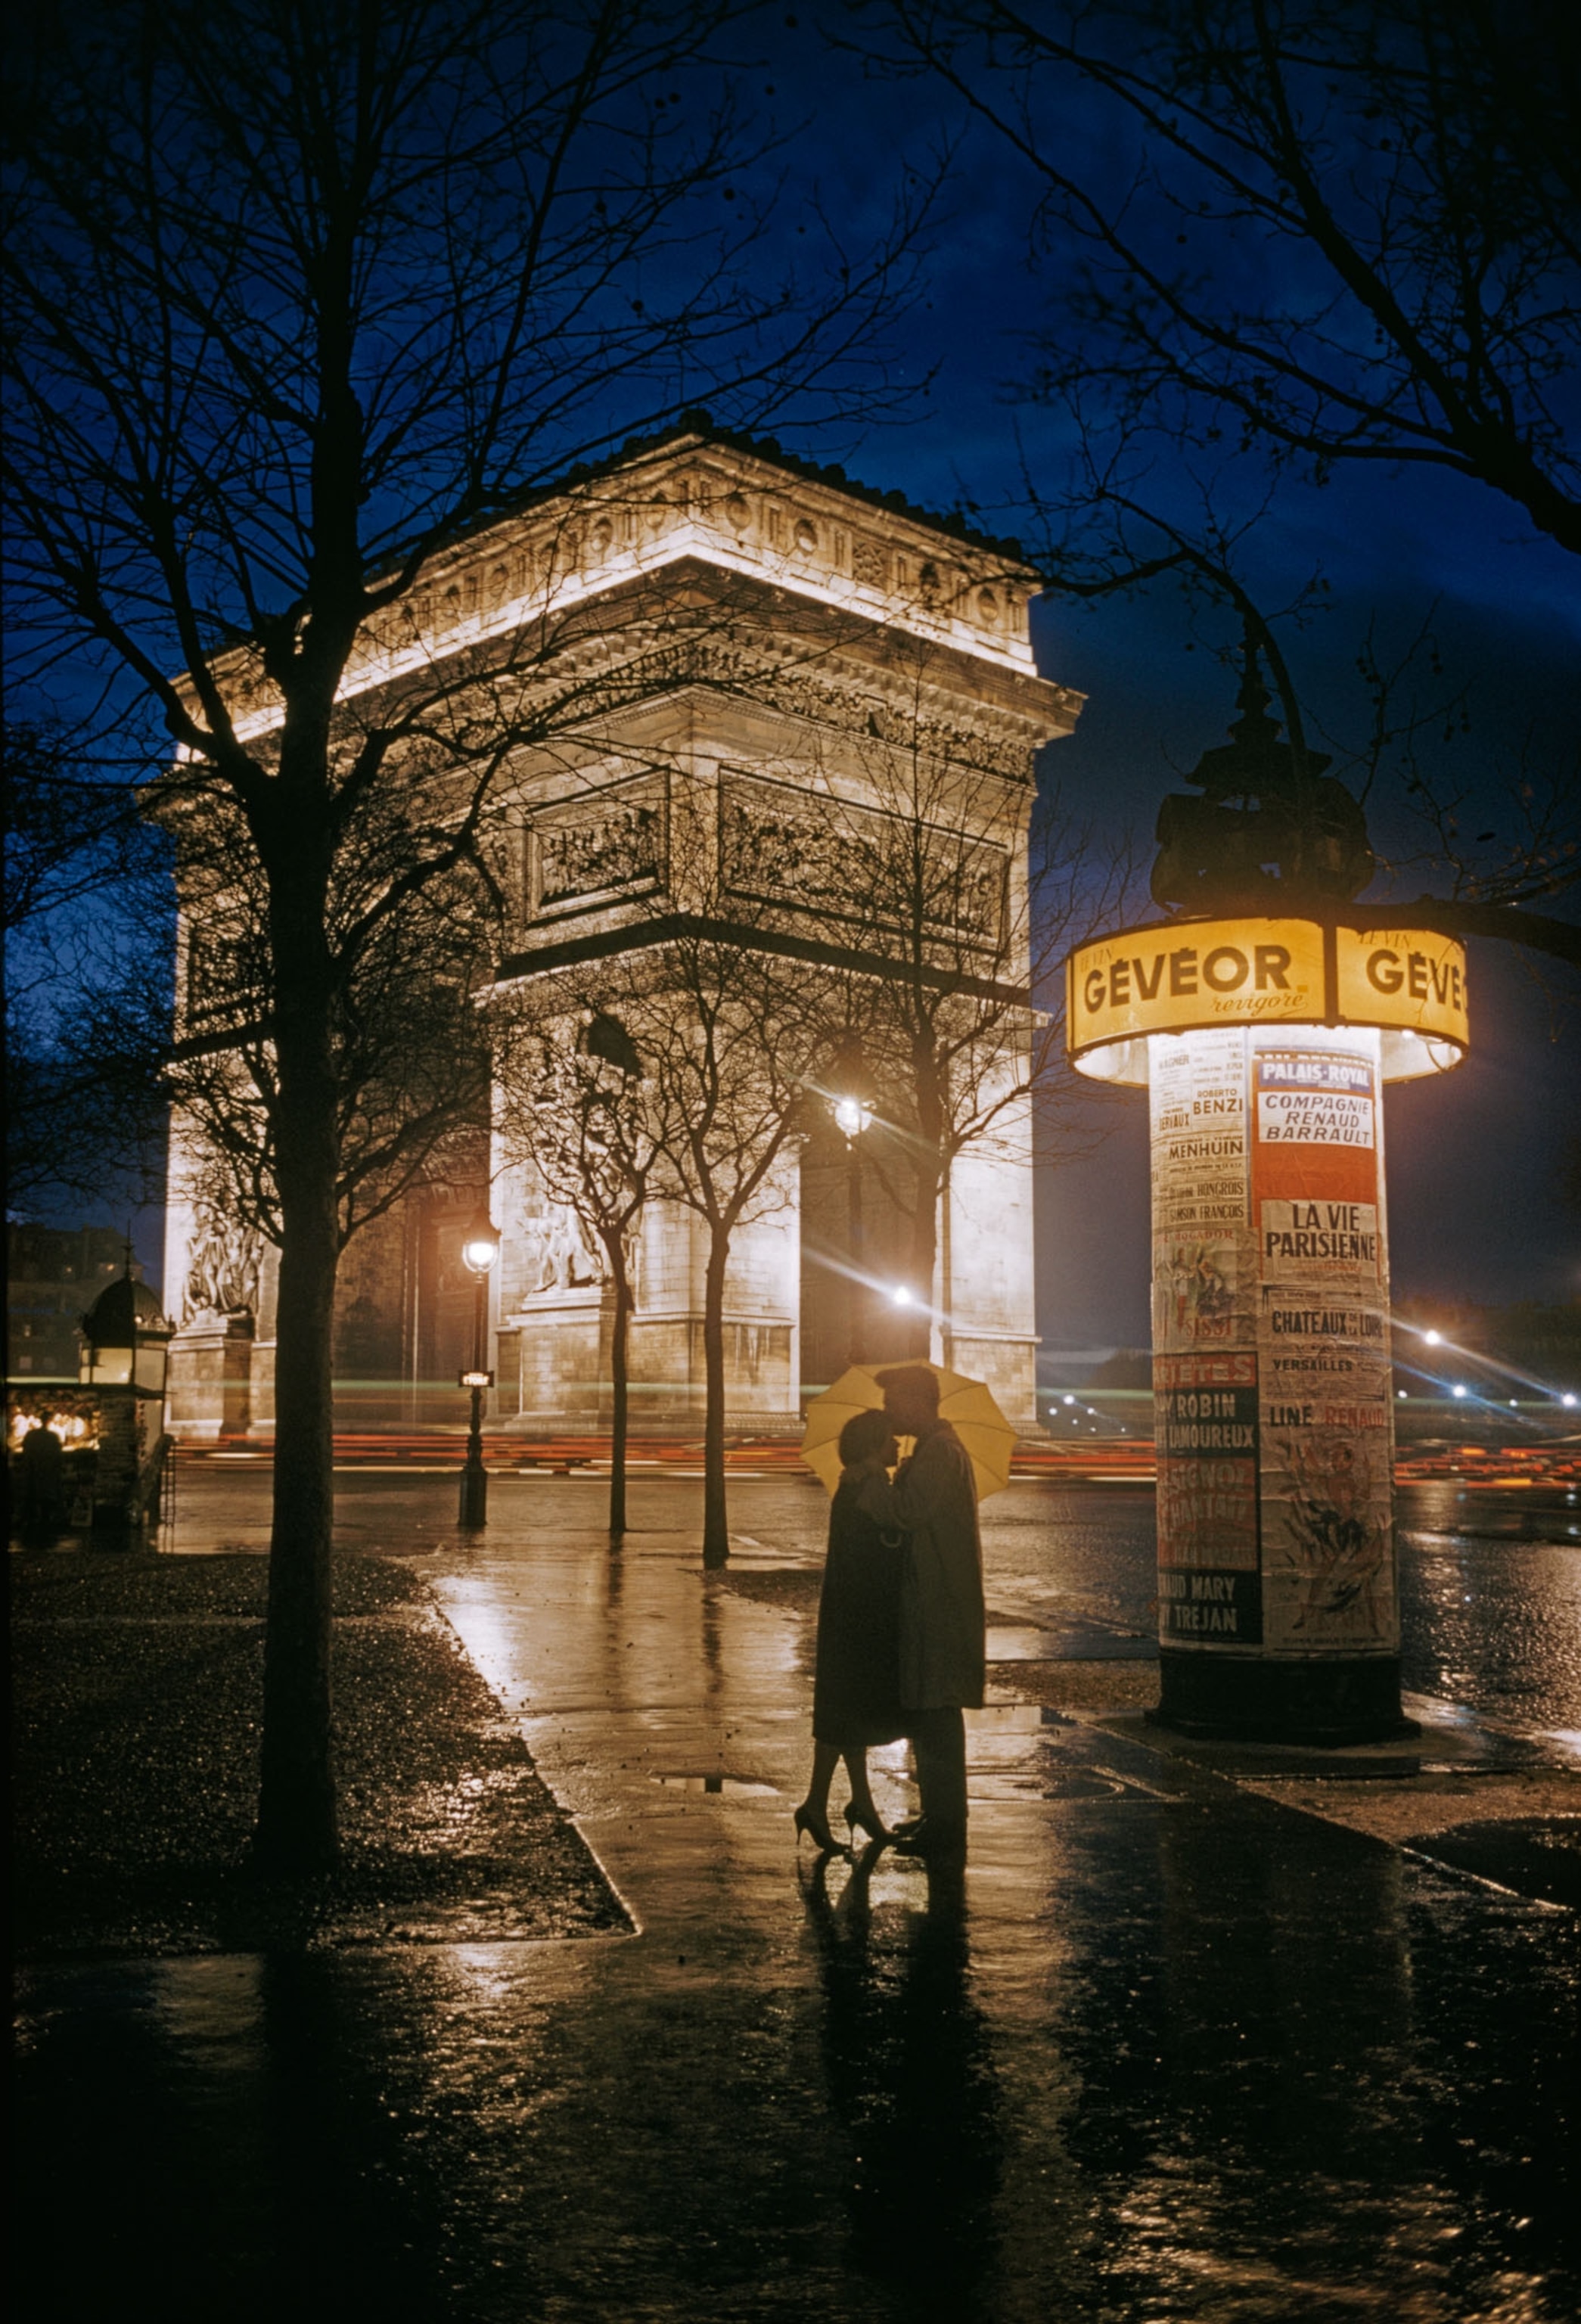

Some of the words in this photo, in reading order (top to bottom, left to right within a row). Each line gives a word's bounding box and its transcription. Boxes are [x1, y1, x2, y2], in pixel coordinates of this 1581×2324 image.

[1084, 944, 1293, 1014] GÉVÉOR
[1366, 949, 1466, 1011] GÉVÉ
[1197, 1089, 1238, 1098] ROBERTO
[1265, 1094, 1370, 1115] COMPAGNIE
[1193, 1098, 1244, 1115] BENZI
[1285, 1111, 1360, 1127] RENAUD
[1266, 1126, 1370, 1145] BARRAULT
[1200, 1204, 1244, 1220] FRANÇOIS
[1292, 1204, 1322, 1230] LA
[1327, 1204, 1360, 1232] VIE
[1266, 1231, 1376, 1262] PARISIENNE
[1272, 1310, 1347, 1335] CHATEAUX
[1272, 1359, 1353, 1372] VERSAILLES
[1177, 1393, 1235, 1418] ROBIN
[1270, 1405, 1312, 1428] LINE
[1325, 1406, 1384, 1428] RENAUD
[1191, 1574, 1236, 1602] MARY
[1174, 1605, 1238, 1633] TREJAN
